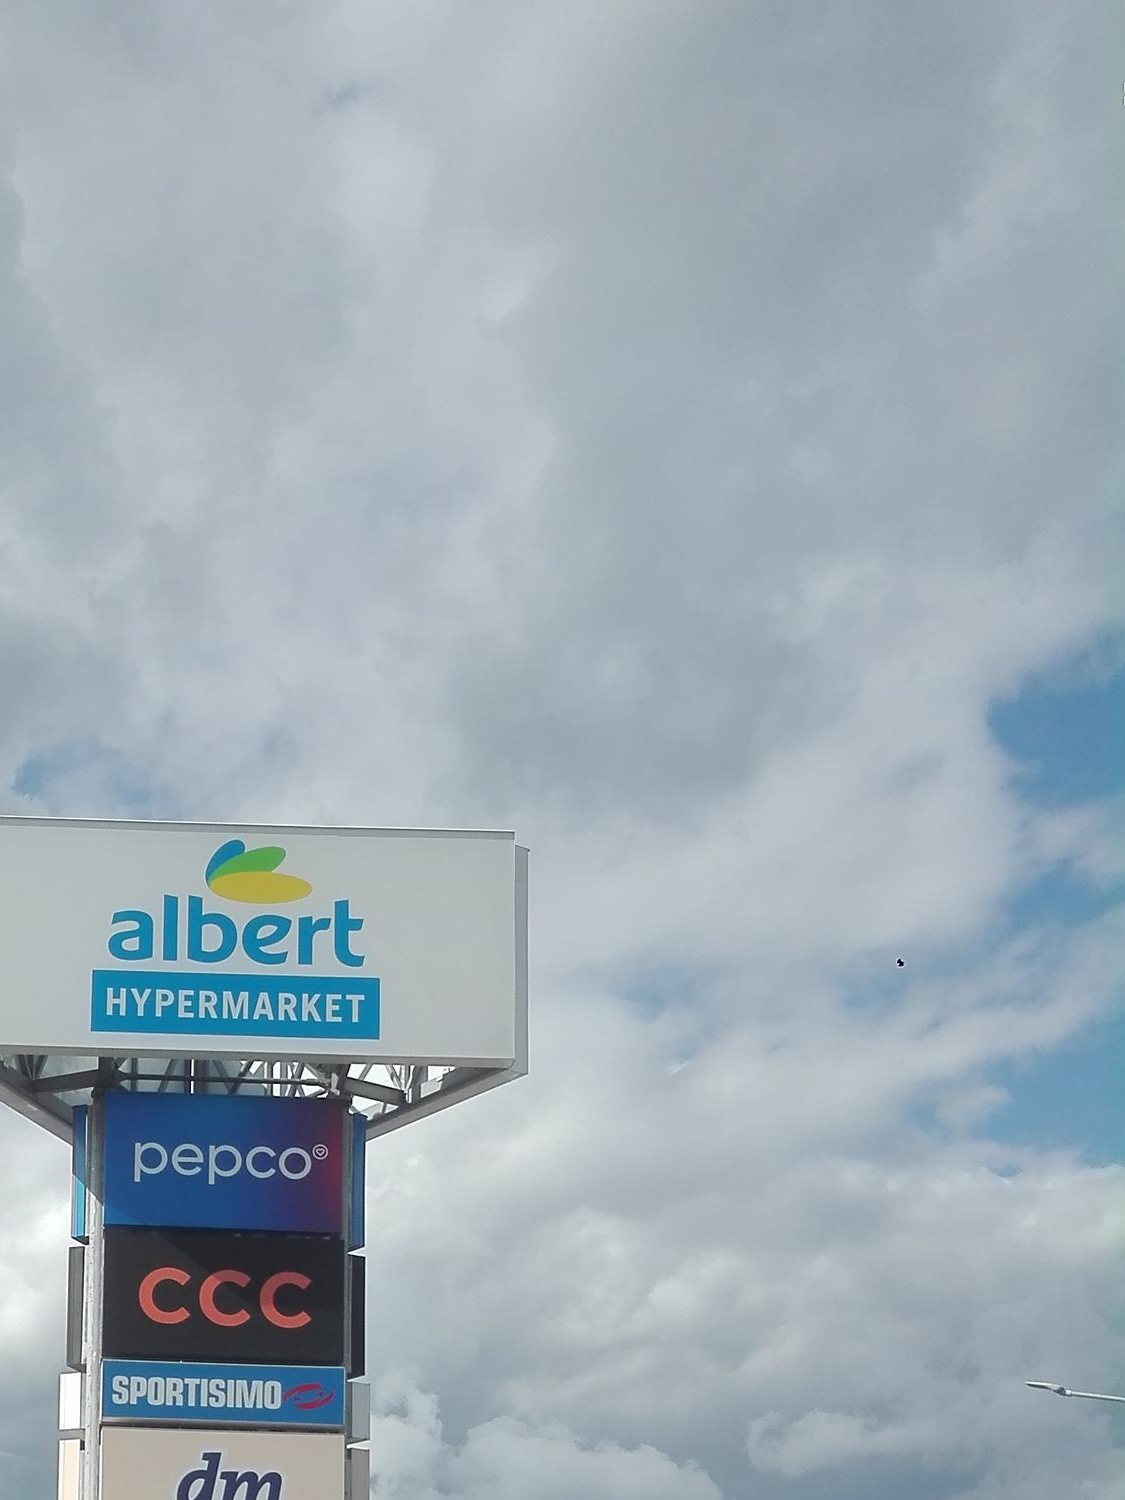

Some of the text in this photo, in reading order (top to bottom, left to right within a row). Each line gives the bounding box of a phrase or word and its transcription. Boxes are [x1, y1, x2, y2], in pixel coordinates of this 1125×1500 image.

[107, 894, 365, 967] albert
[106, 986, 366, 1023] HYPERMARKET
[133, 1139, 311, 1185] pepco
[138, 1267, 312, 1329] CCC
[111, 1375, 283, 1410] SPORTISIMO
